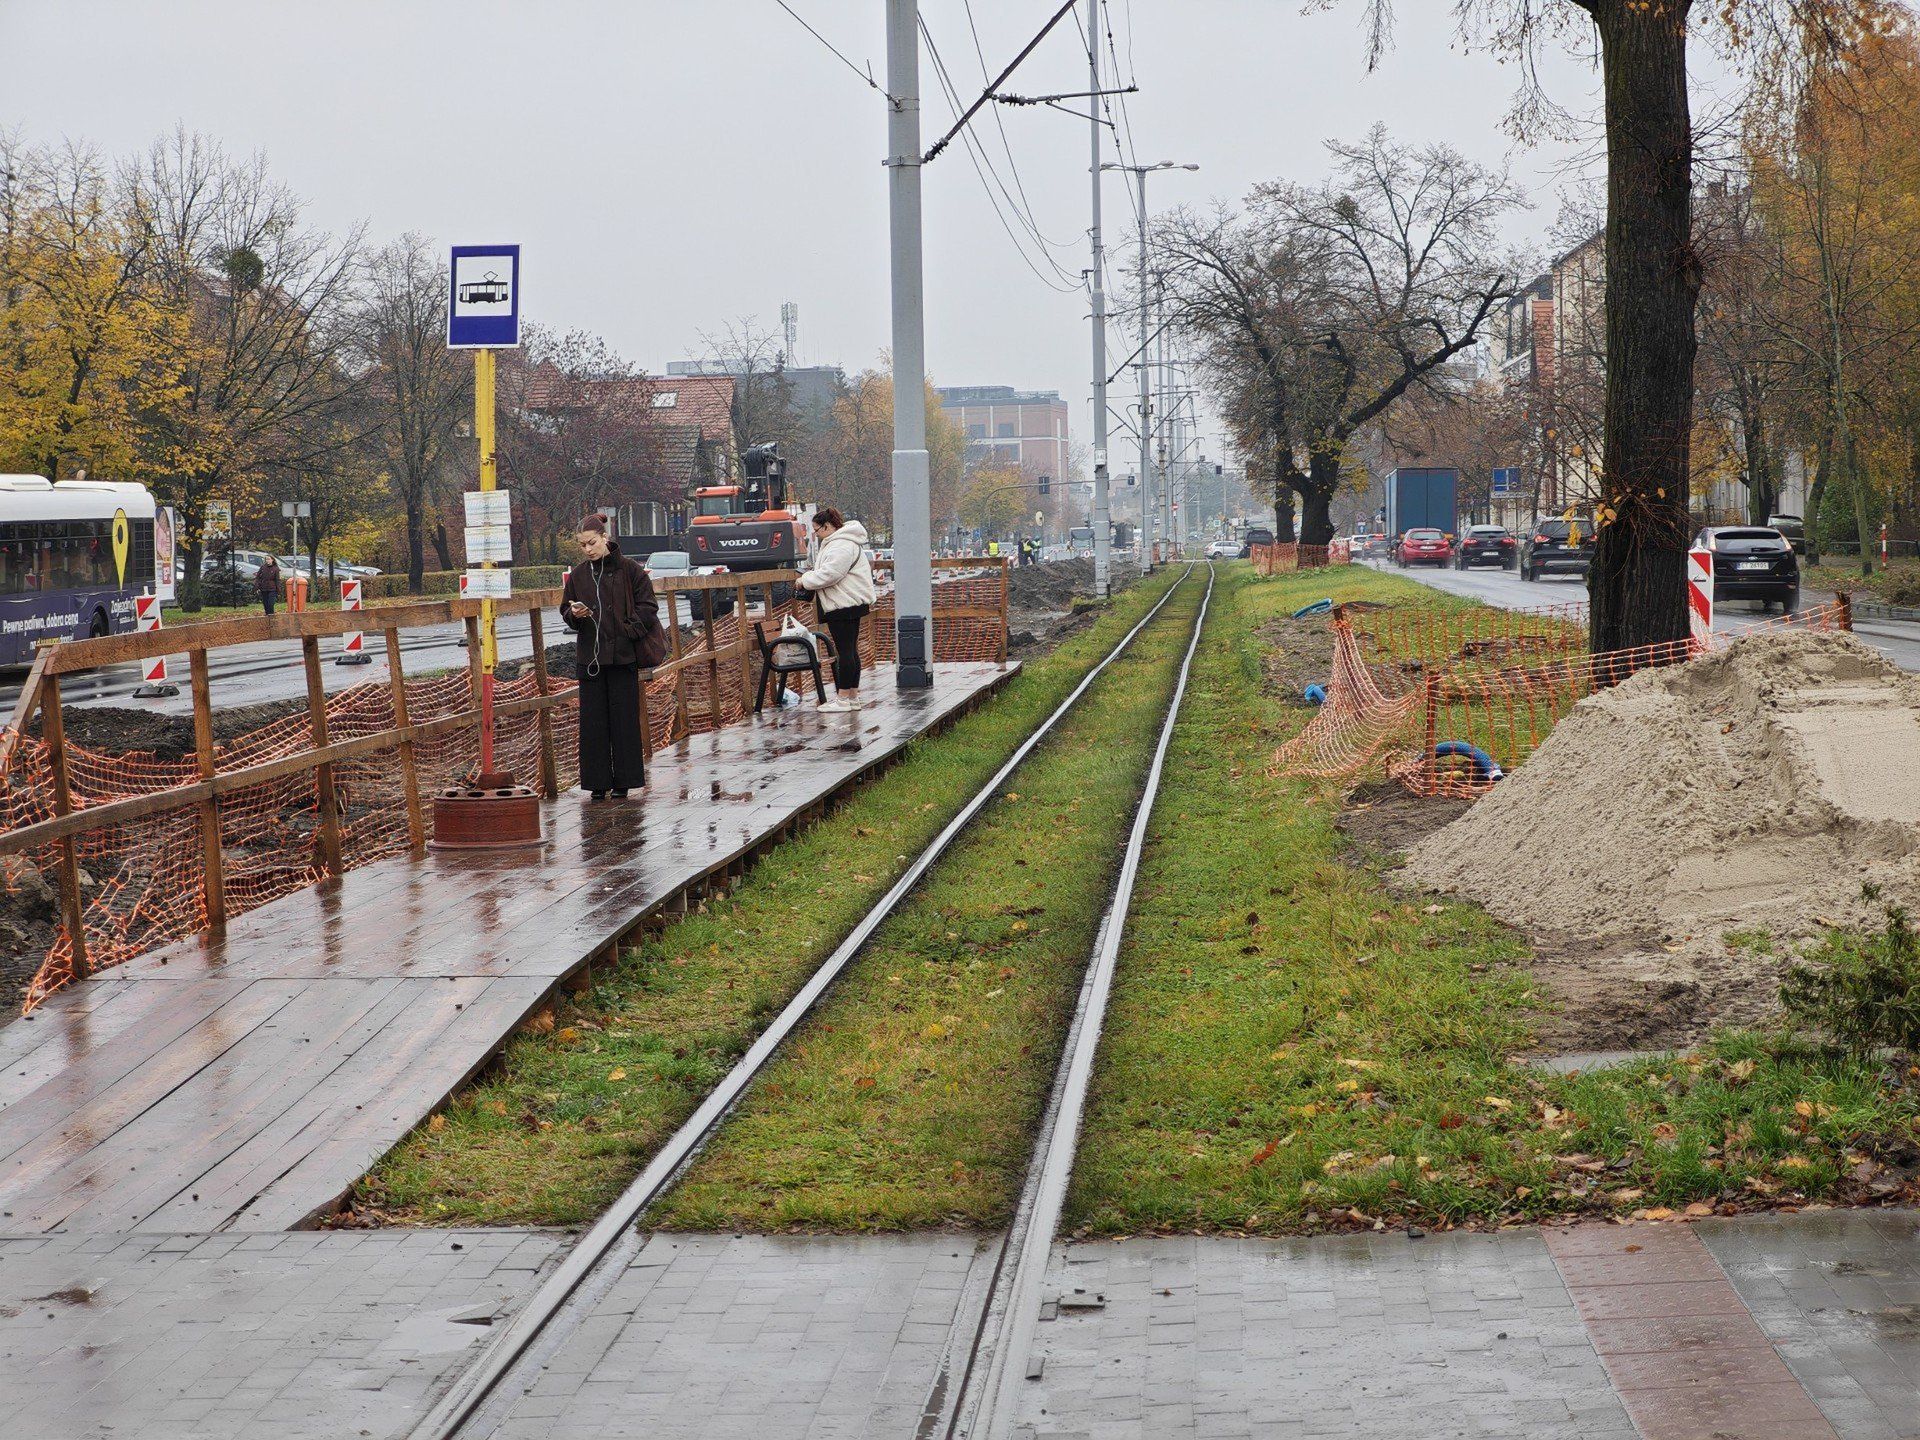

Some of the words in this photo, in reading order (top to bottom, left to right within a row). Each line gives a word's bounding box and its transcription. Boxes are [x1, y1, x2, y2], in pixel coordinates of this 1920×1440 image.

[718, 538, 759, 547] VOLVO
[3, 620, 24, 633] Pewne
[46, 613, 64, 628] dobra
[64, 613, 79, 626] cena
